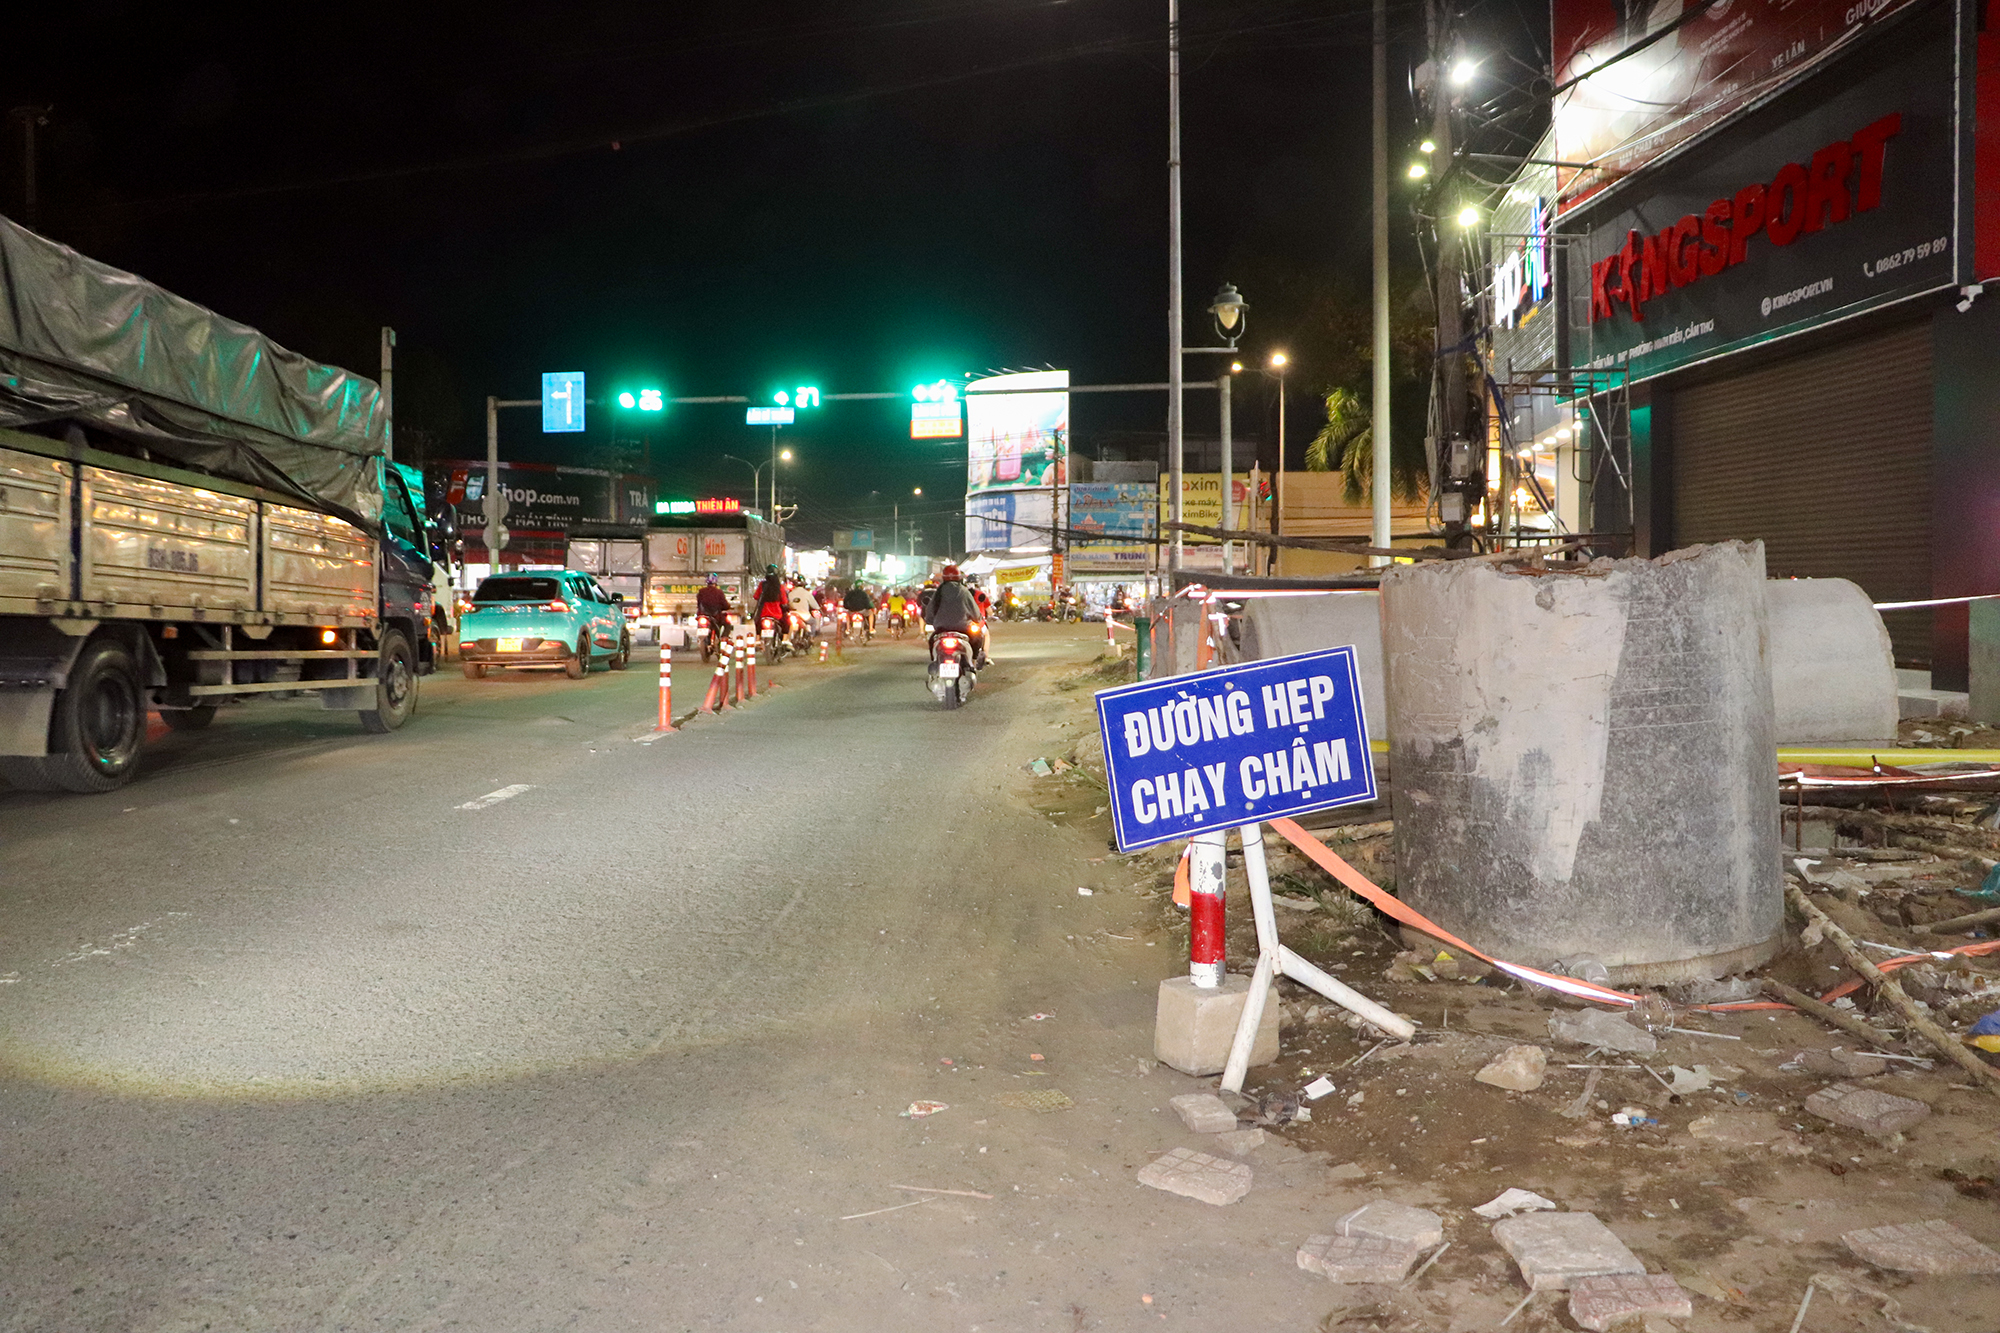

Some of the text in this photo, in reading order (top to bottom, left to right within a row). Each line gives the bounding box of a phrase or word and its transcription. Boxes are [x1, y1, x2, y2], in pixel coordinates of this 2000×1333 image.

[1875, 236, 1948, 274] 0862 79 59 89
[1771, 277, 1834, 311] KINGSPORT.VN
[696, 498, 723, 512] THIÊN
[724, 498, 740, 512] ÂN
[676, 537, 726, 556] Cô Minh
[1123, 675, 1335, 758] ĐƯỜNG HẸP
[1131, 736, 1352, 824] CHẠY CHẬM
